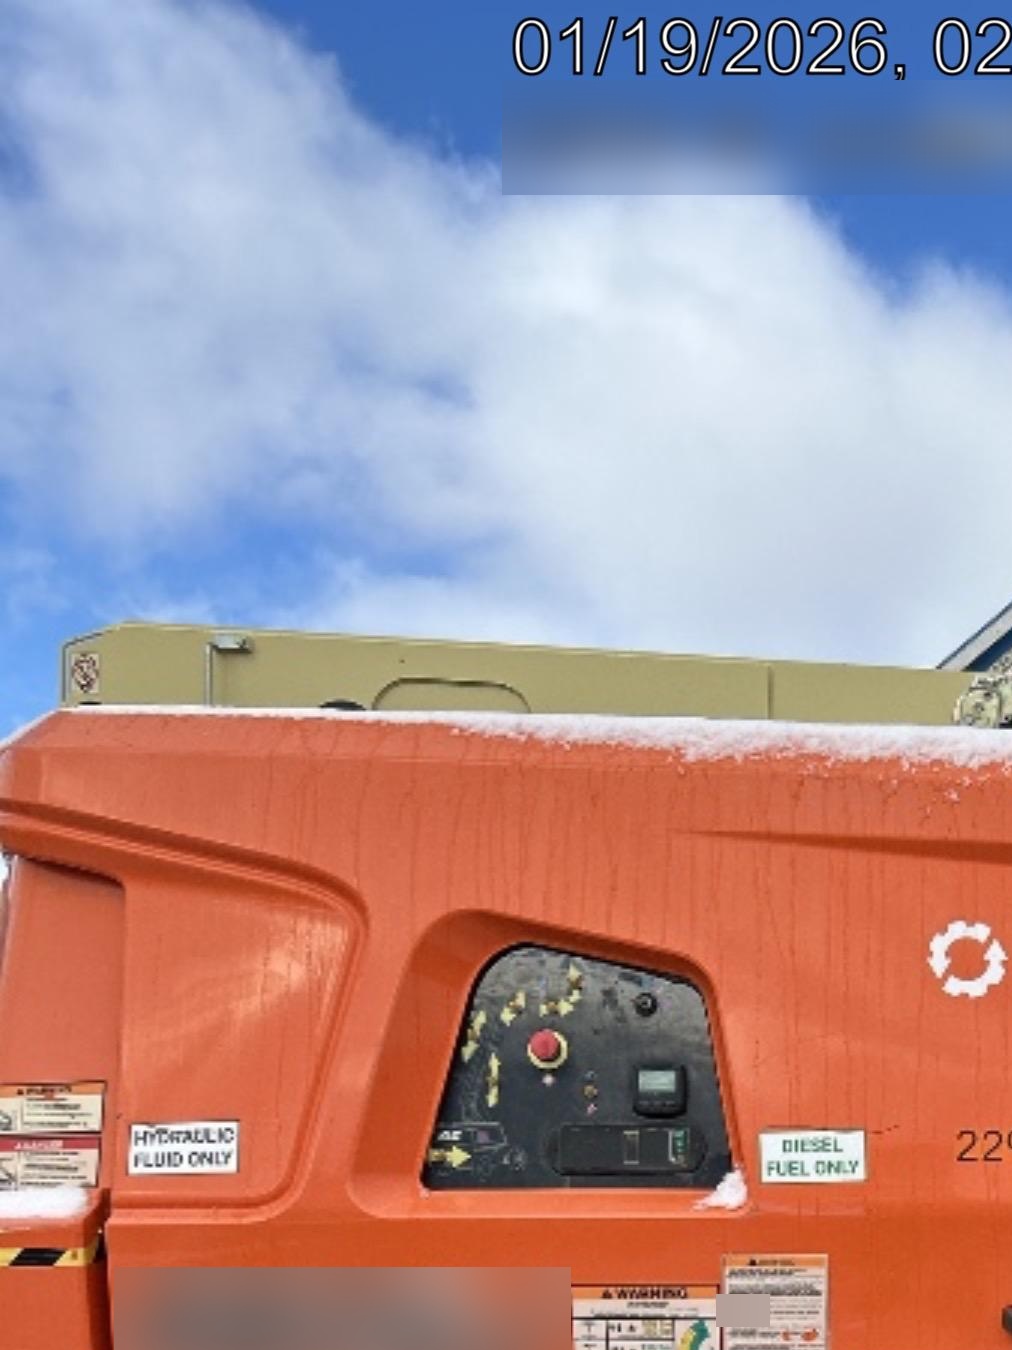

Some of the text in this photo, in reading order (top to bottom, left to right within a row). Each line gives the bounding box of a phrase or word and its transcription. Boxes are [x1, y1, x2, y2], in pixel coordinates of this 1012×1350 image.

[133, 1127, 235, 1147] HYDRAULIC
[782, 1137, 844, 1153] DIESEL
[133, 1149, 233, 1169] FLUID ONLY
[767, 1160, 859, 1177] FUEL ONLY
